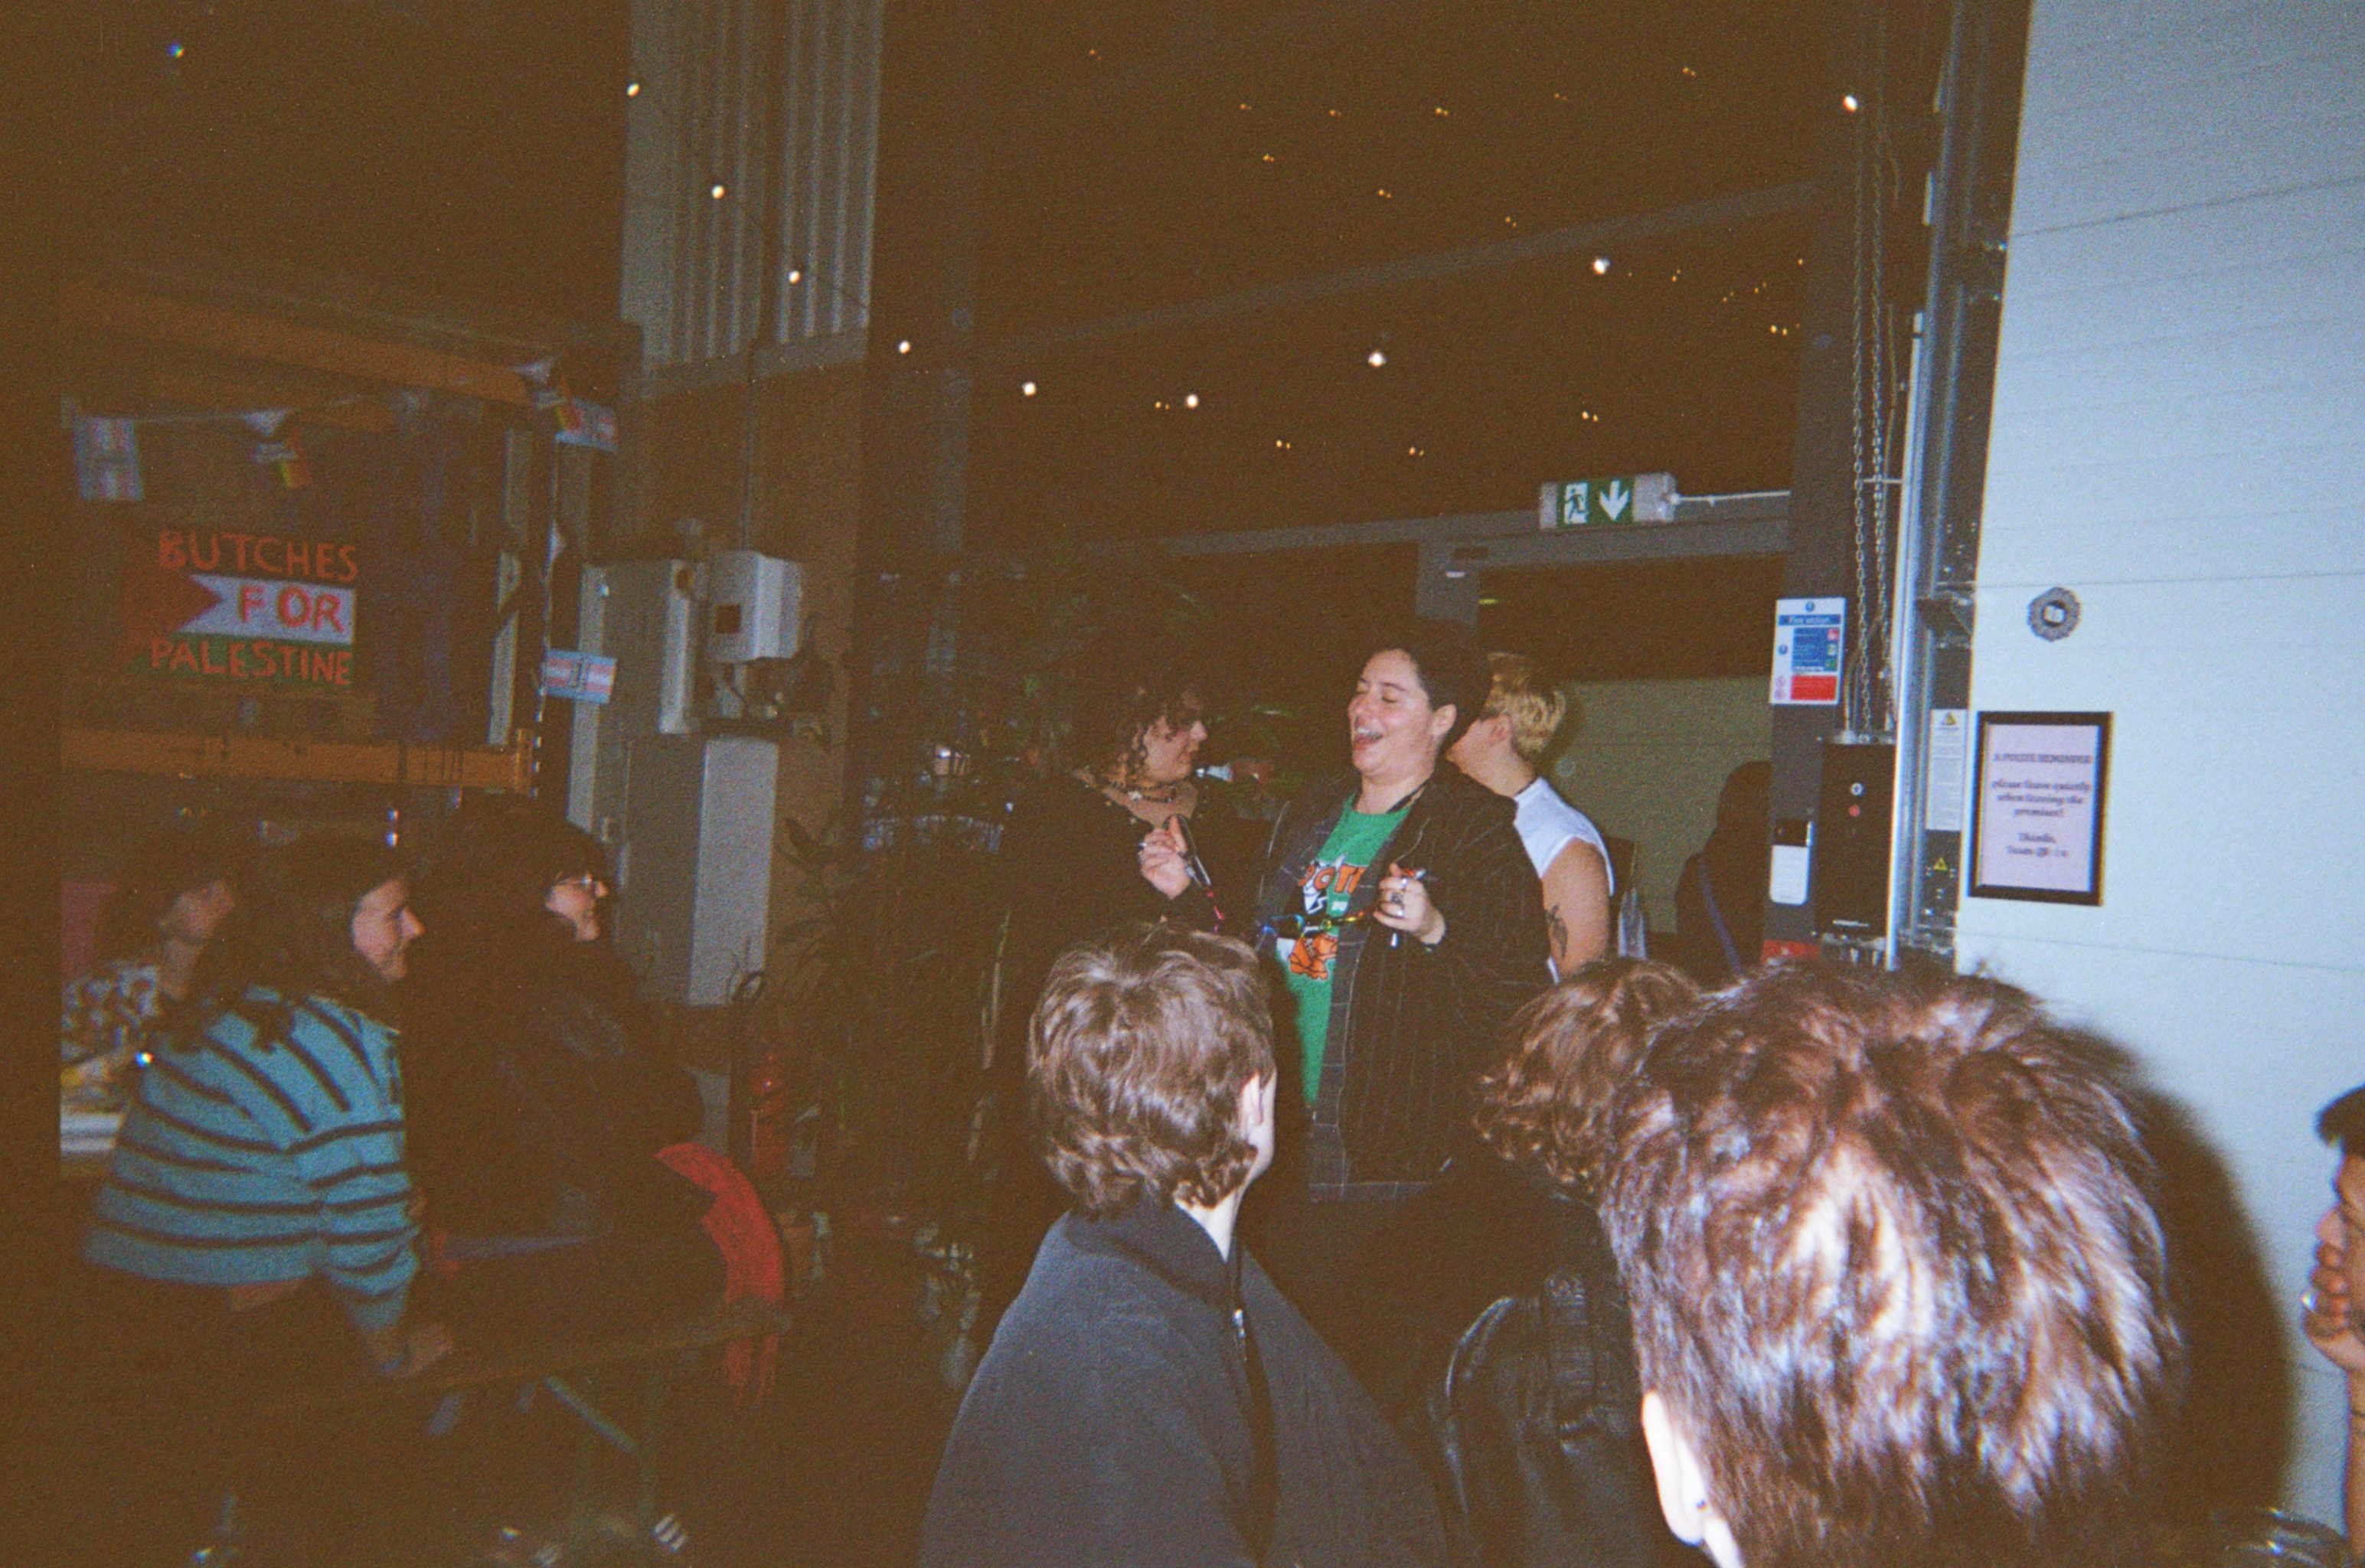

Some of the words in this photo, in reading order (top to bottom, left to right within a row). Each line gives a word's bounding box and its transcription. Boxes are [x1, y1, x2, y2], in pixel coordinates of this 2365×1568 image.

[158, 530, 359, 583] BUTCHES
[240, 585, 346, 634] FOR
[152, 636, 353, 687] PALESTINE
